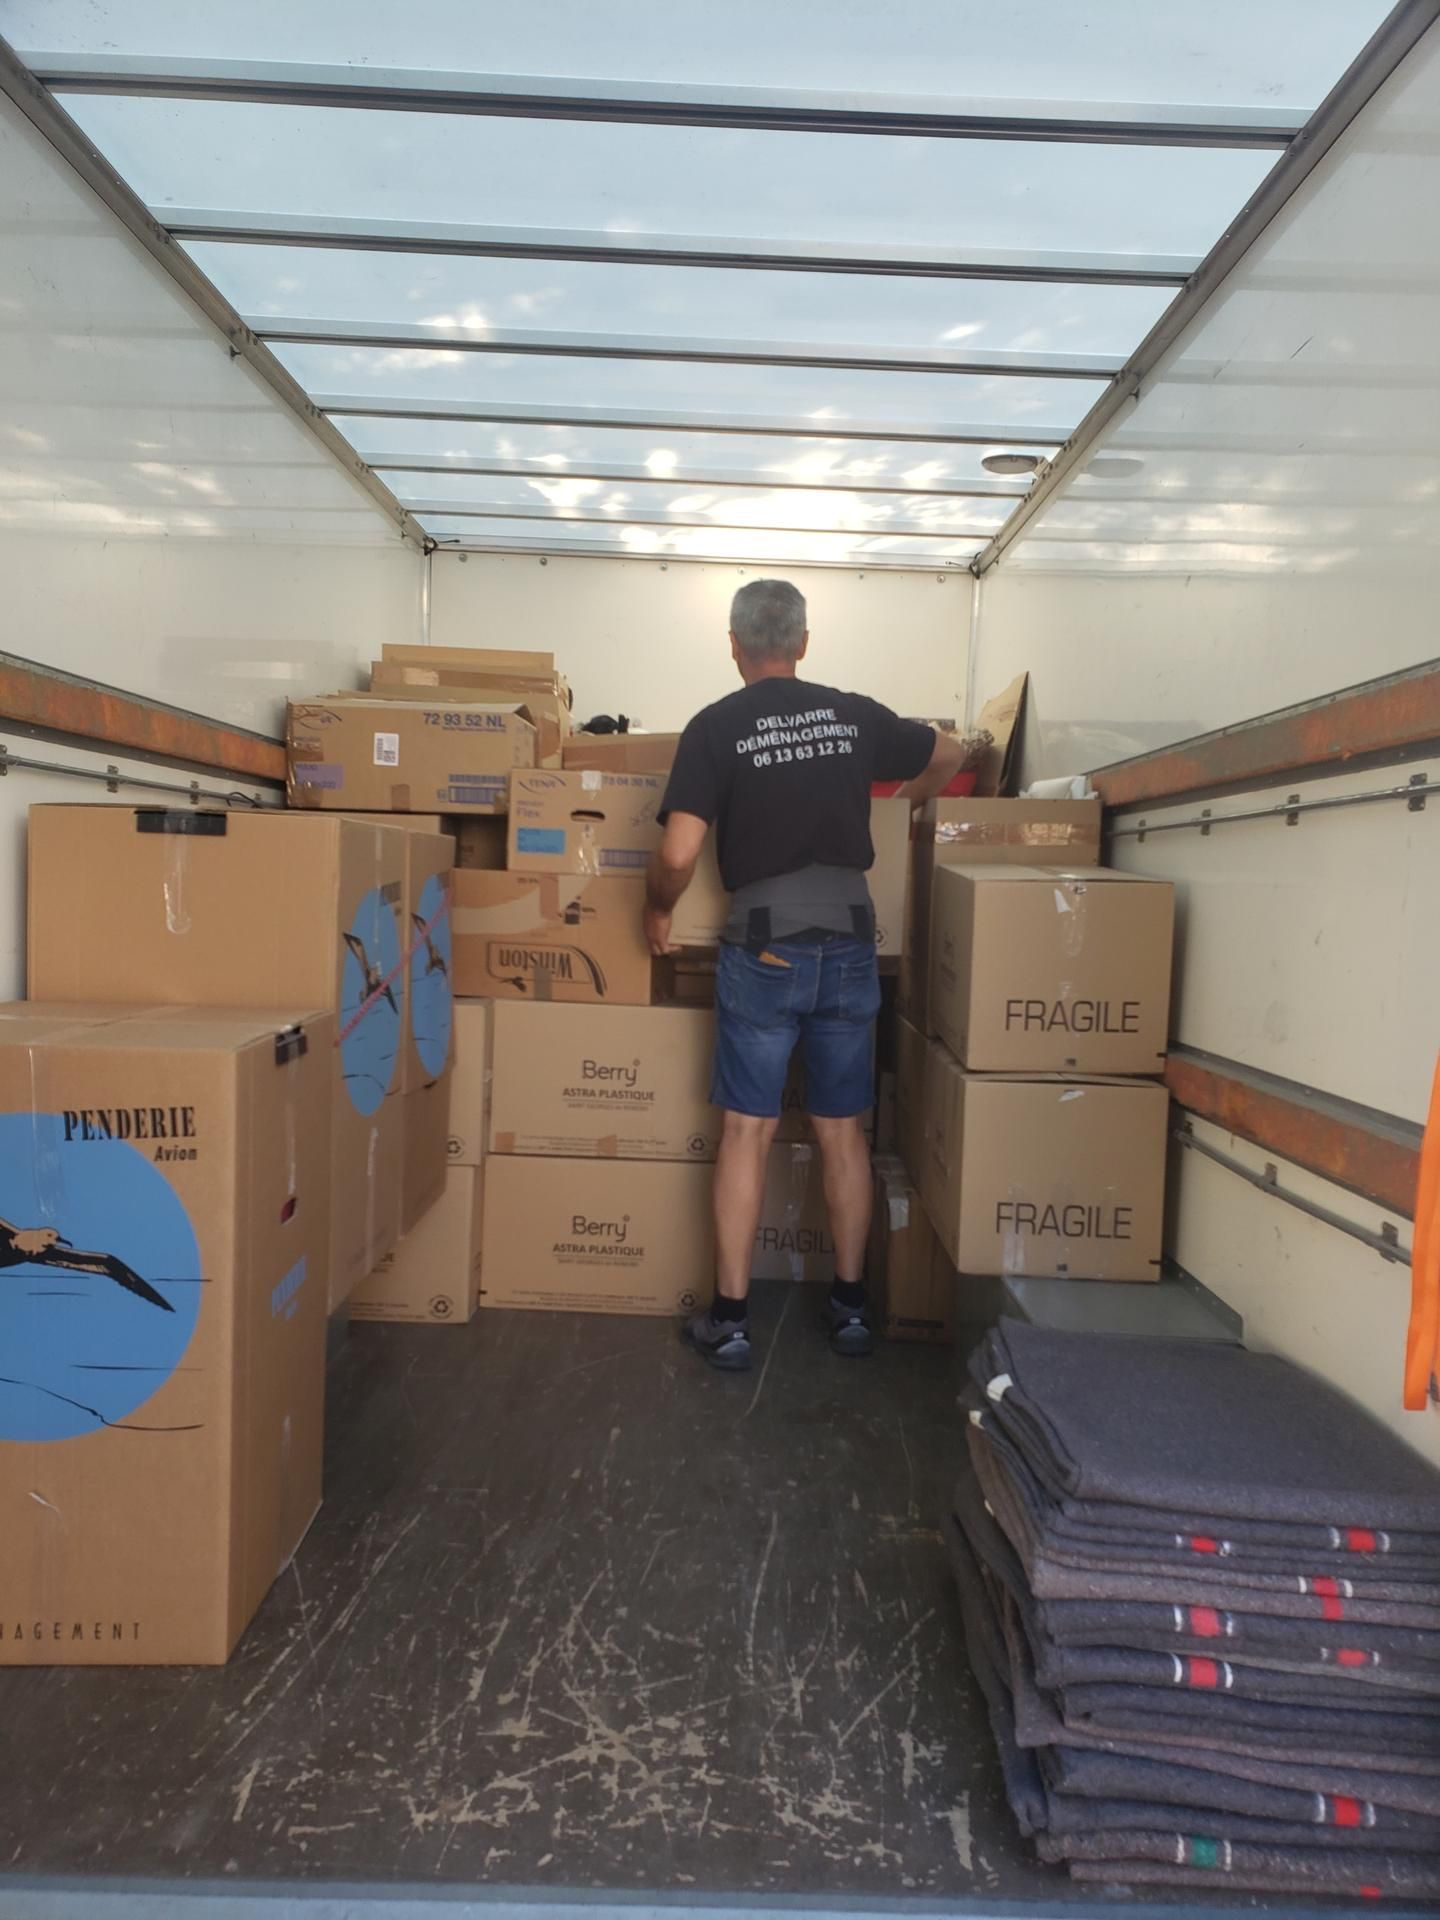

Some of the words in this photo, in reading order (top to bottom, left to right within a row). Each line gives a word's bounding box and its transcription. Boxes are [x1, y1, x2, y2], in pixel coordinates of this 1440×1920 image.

[423, 712, 440, 725] 72
[443, 713, 460, 726] 93
[464, 714, 481, 727] 52
[486, 715, 506, 729] NL
[756, 708, 837, 731] DELVARRE
[753, 751, 771, 768] 06
[775, 748, 793, 763] 13
[795, 745, 814, 760] 63
[817, 741, 835, 756] 12
[837, 740, 852, 754] 26
[499, 949, 573, 979] Winston
[1005, 1000, 1141, 1033] FRAGILE
[562, 1088, 596, 1098] ASTRA
[598, 1089, 655, 1101] PLASTIQUE
[63, 1106, 197, 1141] PENDERIE
[153, 1145, 198, 1162] Avion
[996, 1201, 1132, 1240] FRAGILE
[553, 1243, 586, 1253] ASTRA
[588, 1244, 645, 1256] PLASTIQUE
[0, 1621, 139, 1641] AGEMENT
